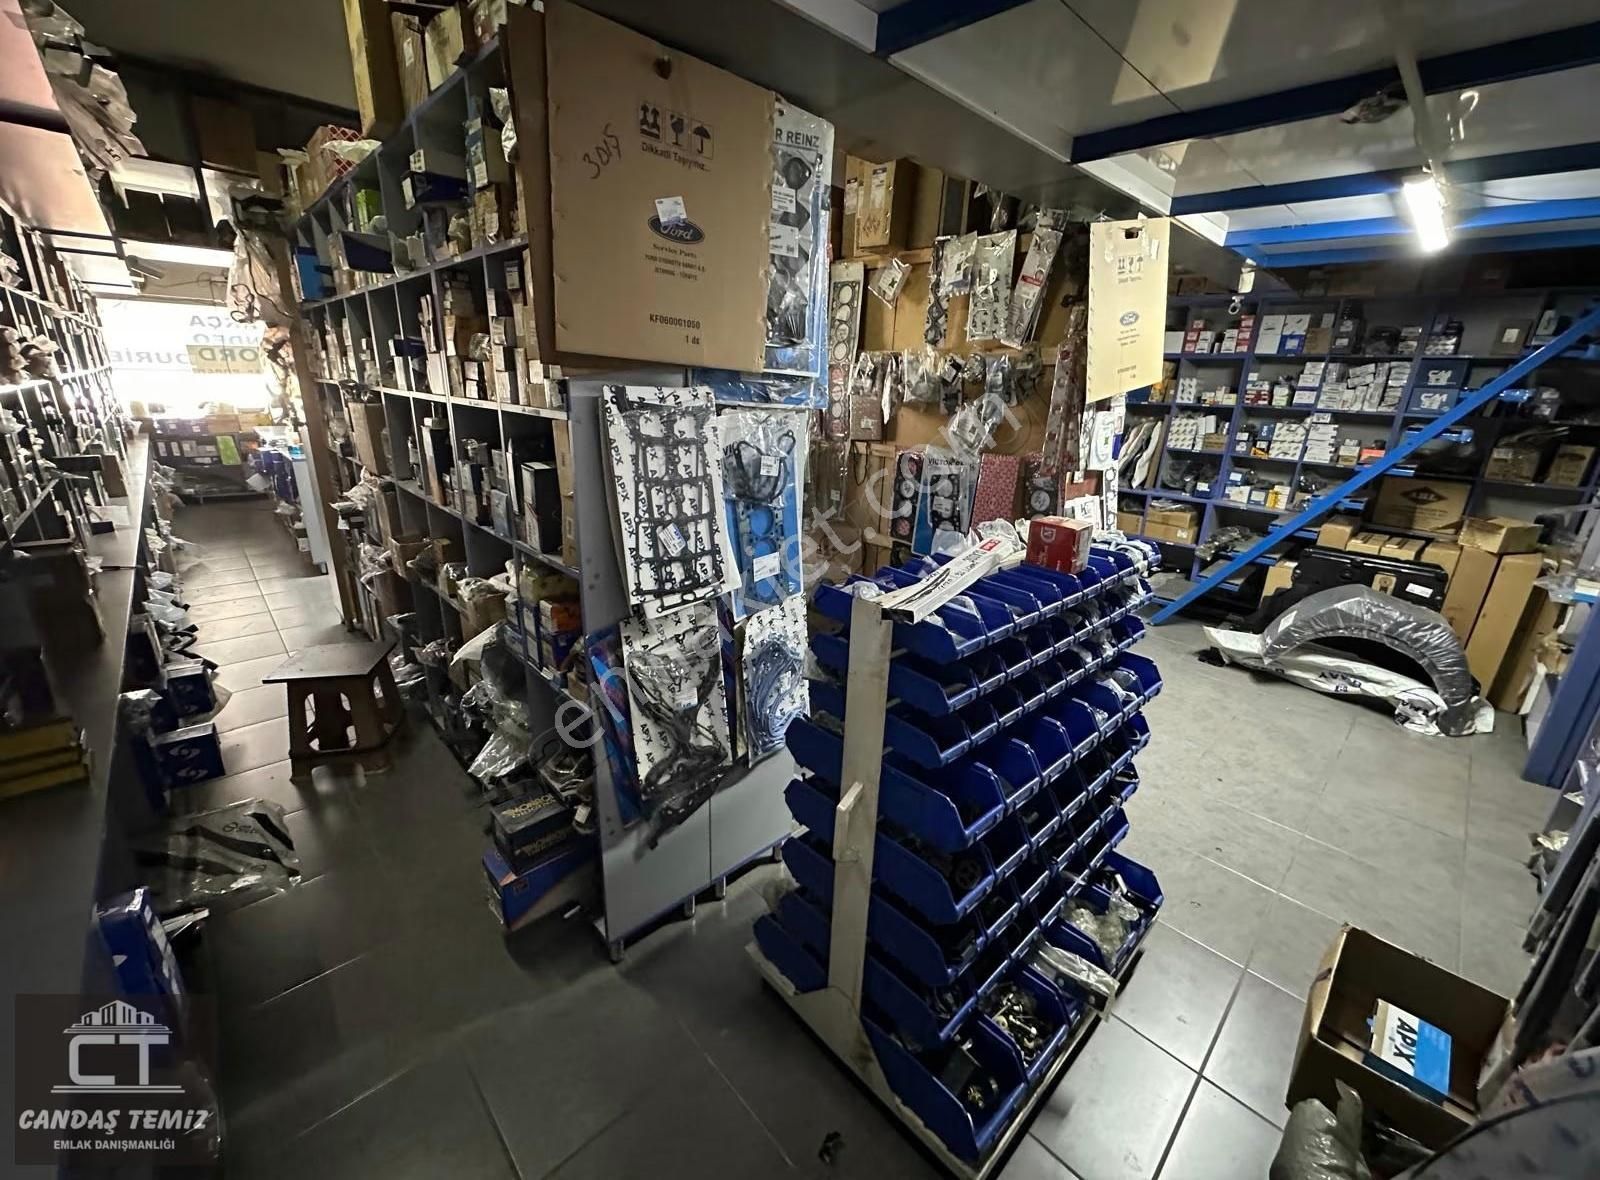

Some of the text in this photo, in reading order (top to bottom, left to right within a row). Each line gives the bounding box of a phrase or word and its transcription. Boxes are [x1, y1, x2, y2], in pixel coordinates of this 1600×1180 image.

[786, 131, 820, 148] REINZ
[609, 438, 624, 466] APIX
[614, 475, 630, 502] APIX
[621, 511, 637, 538] APIX
[642, 525, 654, 551] APIX
[641, 724, 654, 746] APIX
[1393, 1017, 1418, 1068] APIX
